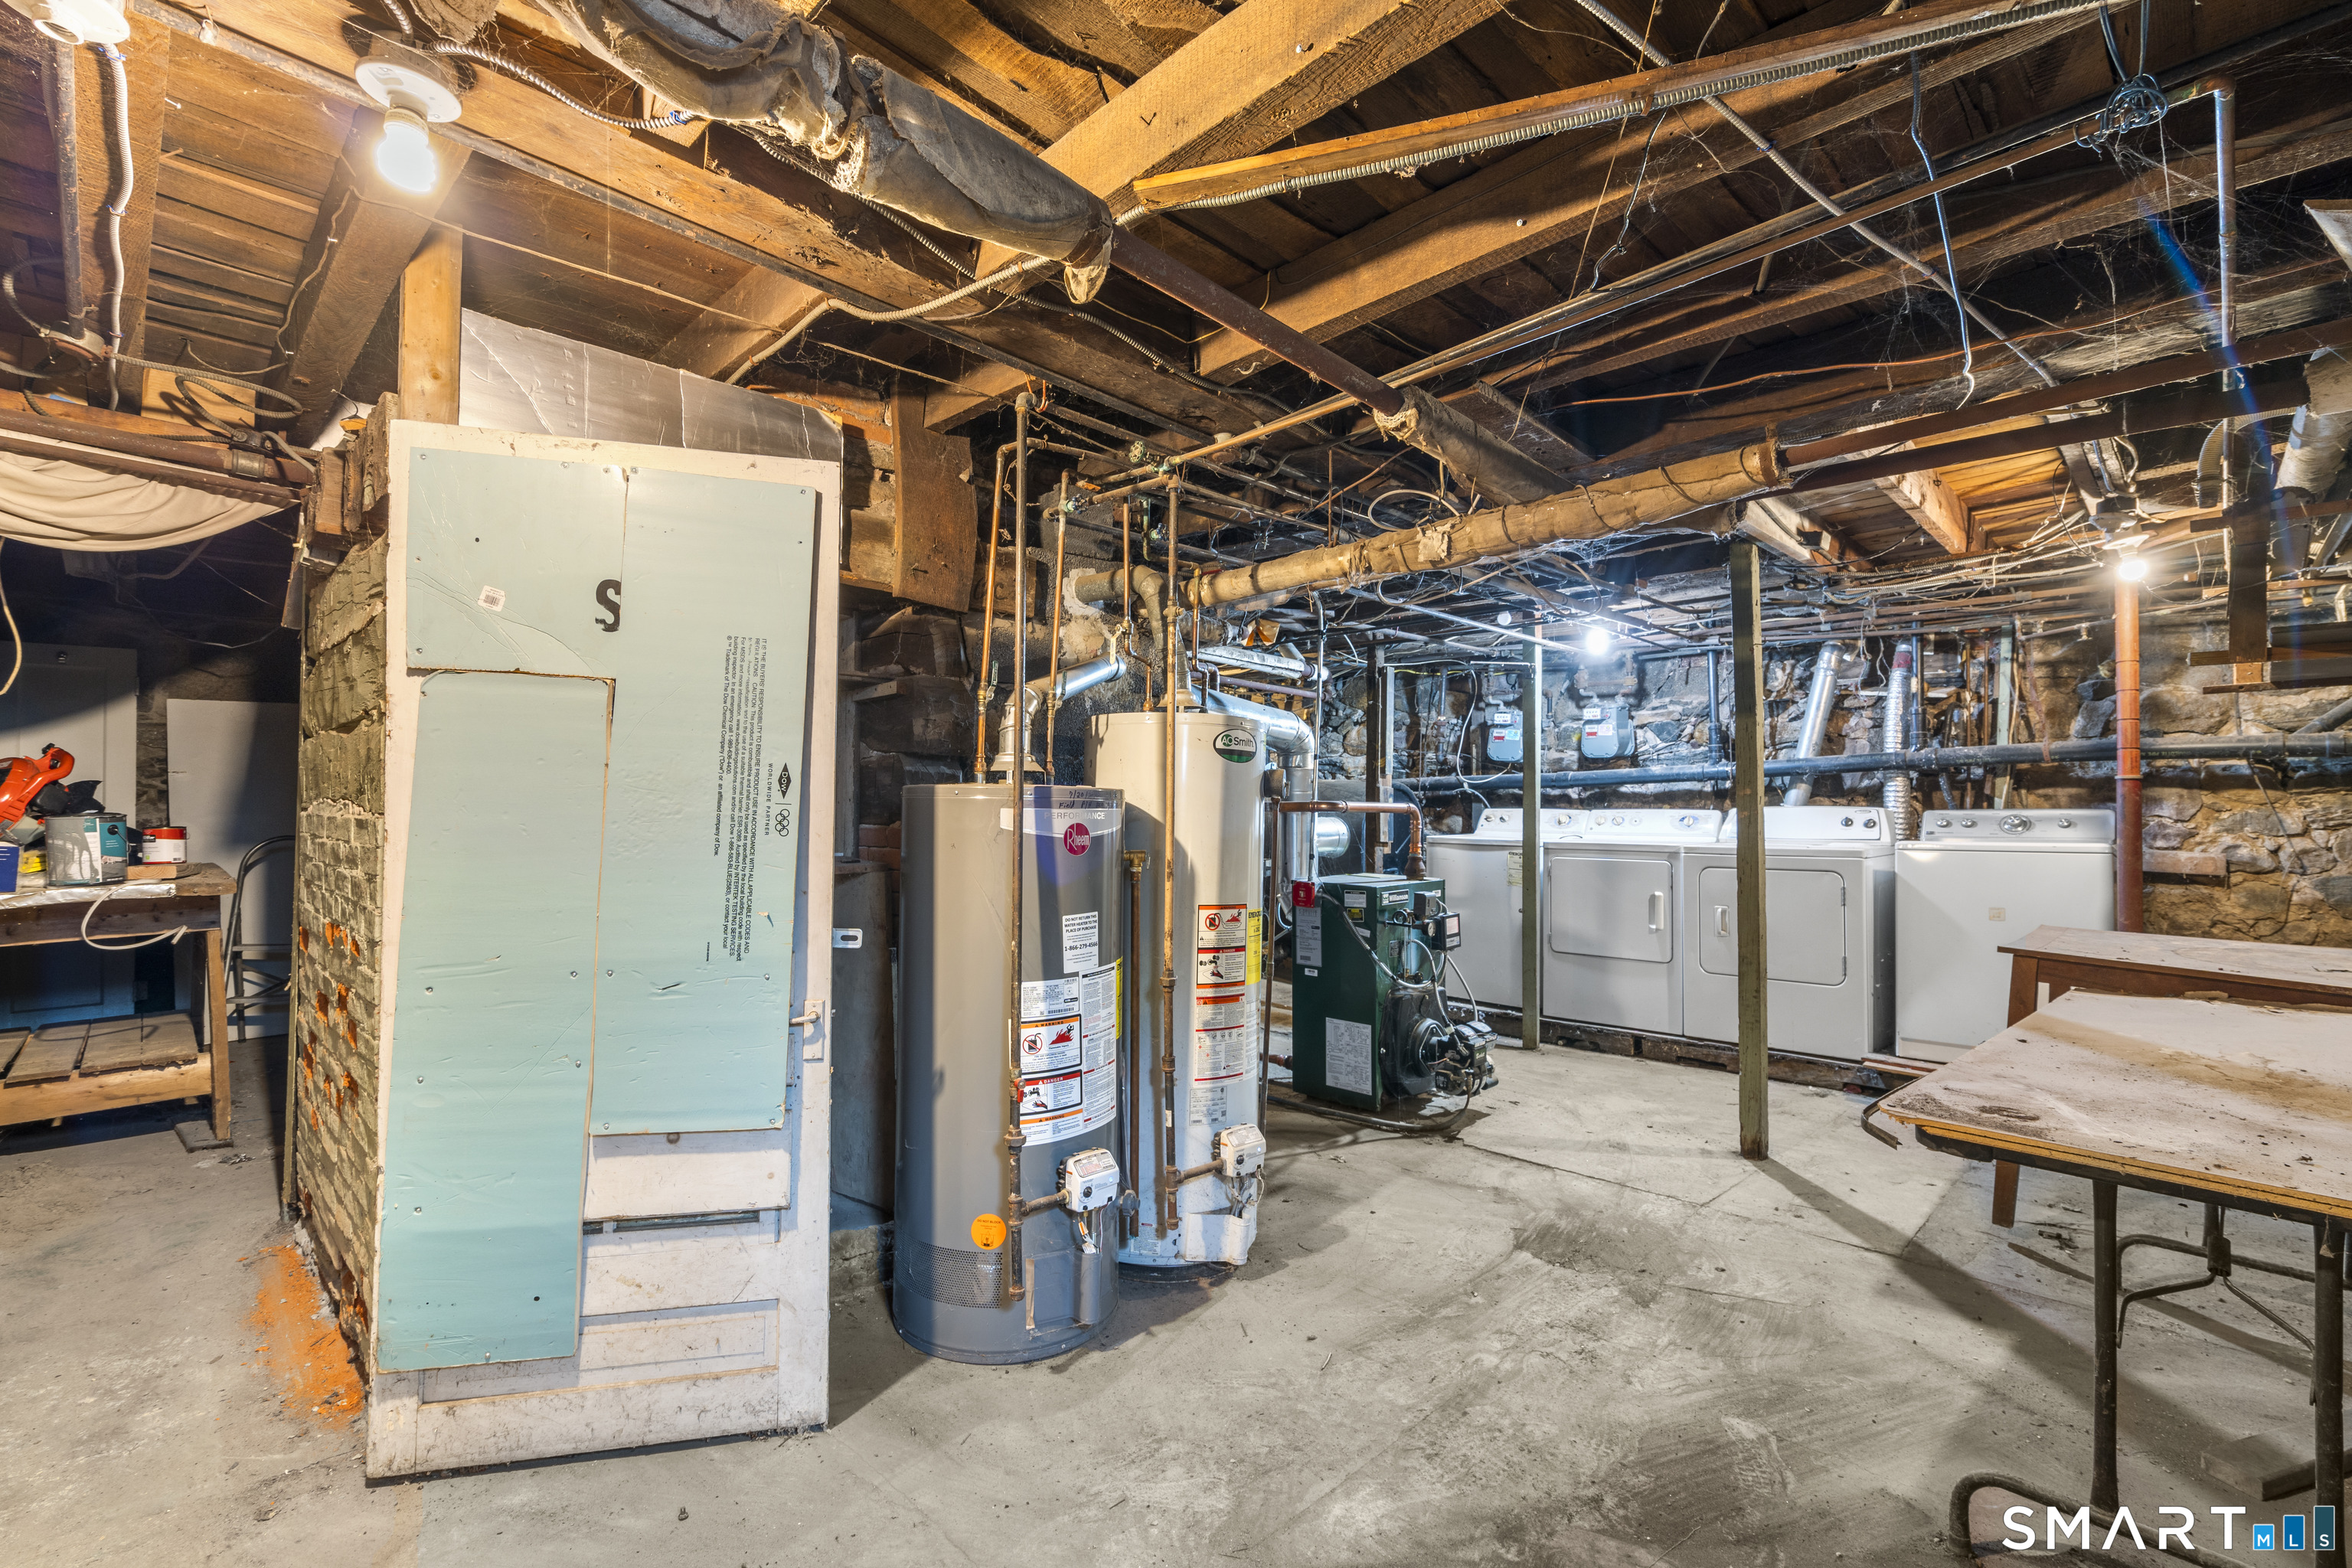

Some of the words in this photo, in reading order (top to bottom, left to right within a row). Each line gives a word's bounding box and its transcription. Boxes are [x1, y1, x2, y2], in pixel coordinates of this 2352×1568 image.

[595, 579, 622, 632] S
[1067, 823, 1089, 850] Rheem
[1389, 893, 1408, 901] Williamson
[1065, 942, 1098, 951] 1-866-279-4566
